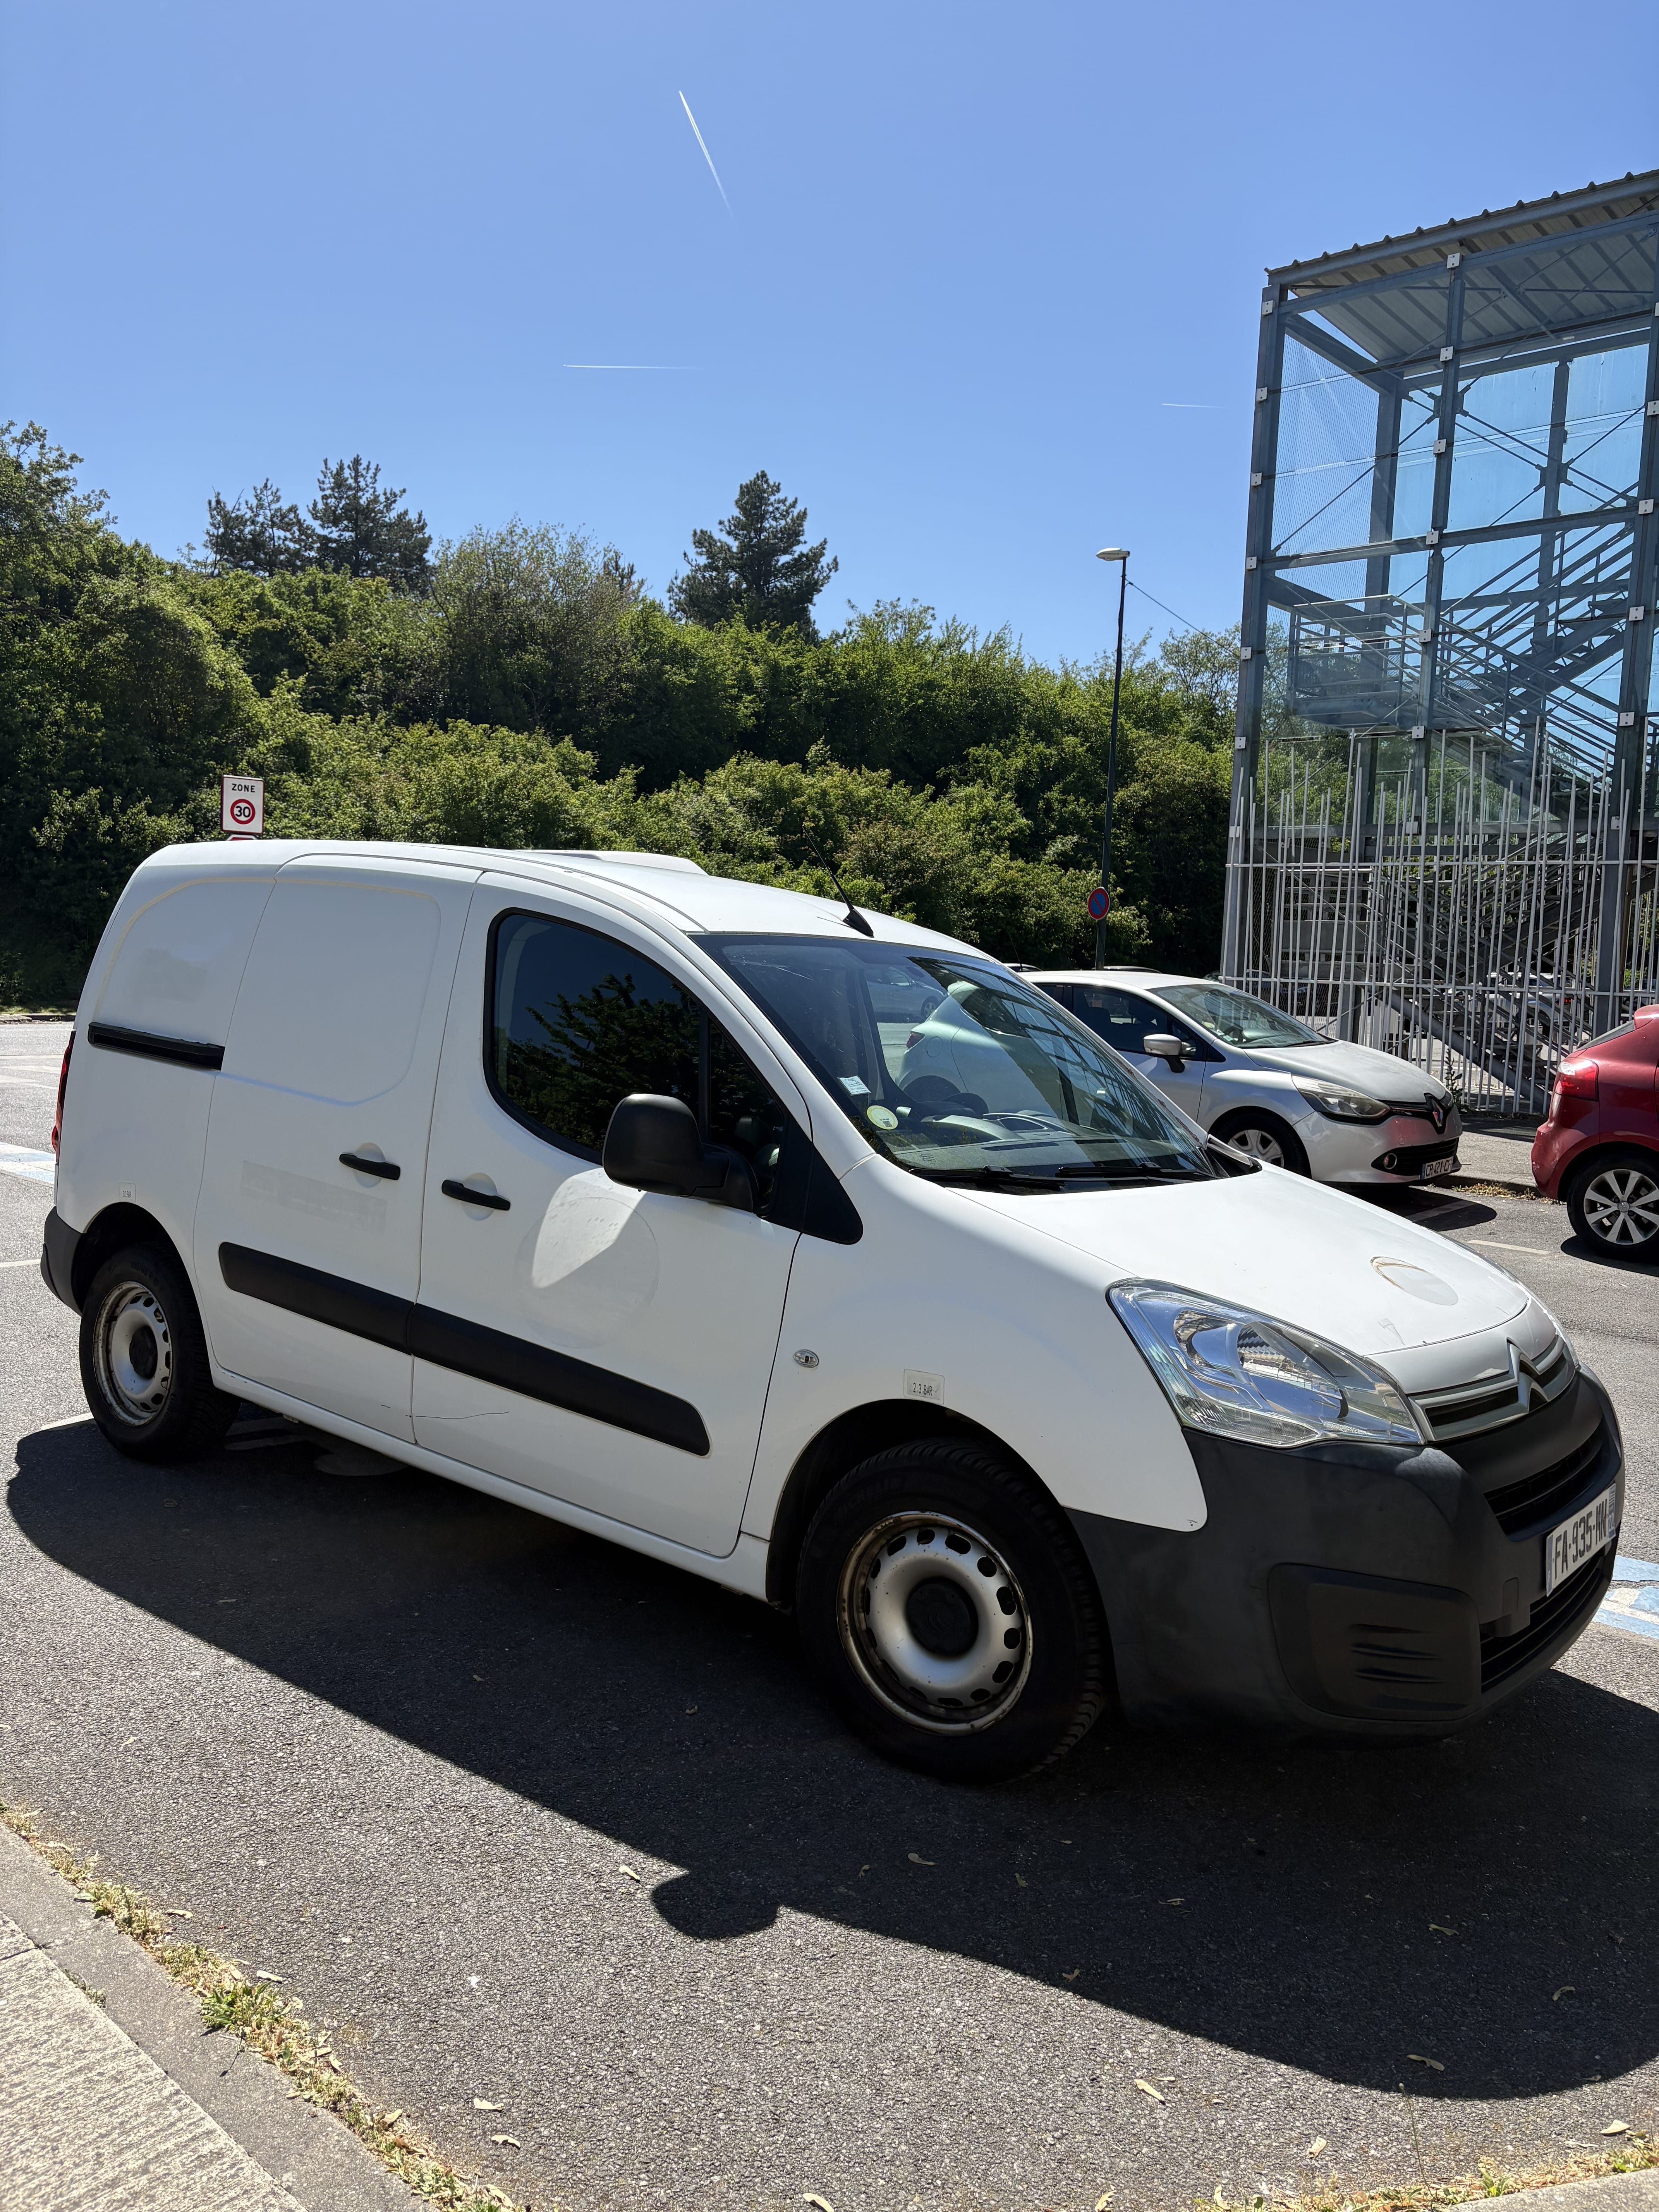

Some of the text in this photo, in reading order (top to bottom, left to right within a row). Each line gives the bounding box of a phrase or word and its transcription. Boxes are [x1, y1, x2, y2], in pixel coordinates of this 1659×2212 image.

[232, 783, 255, 793] ZONE
[235, 805, 251, 818] 30
[924, 1384, 933, 1396] BAR
